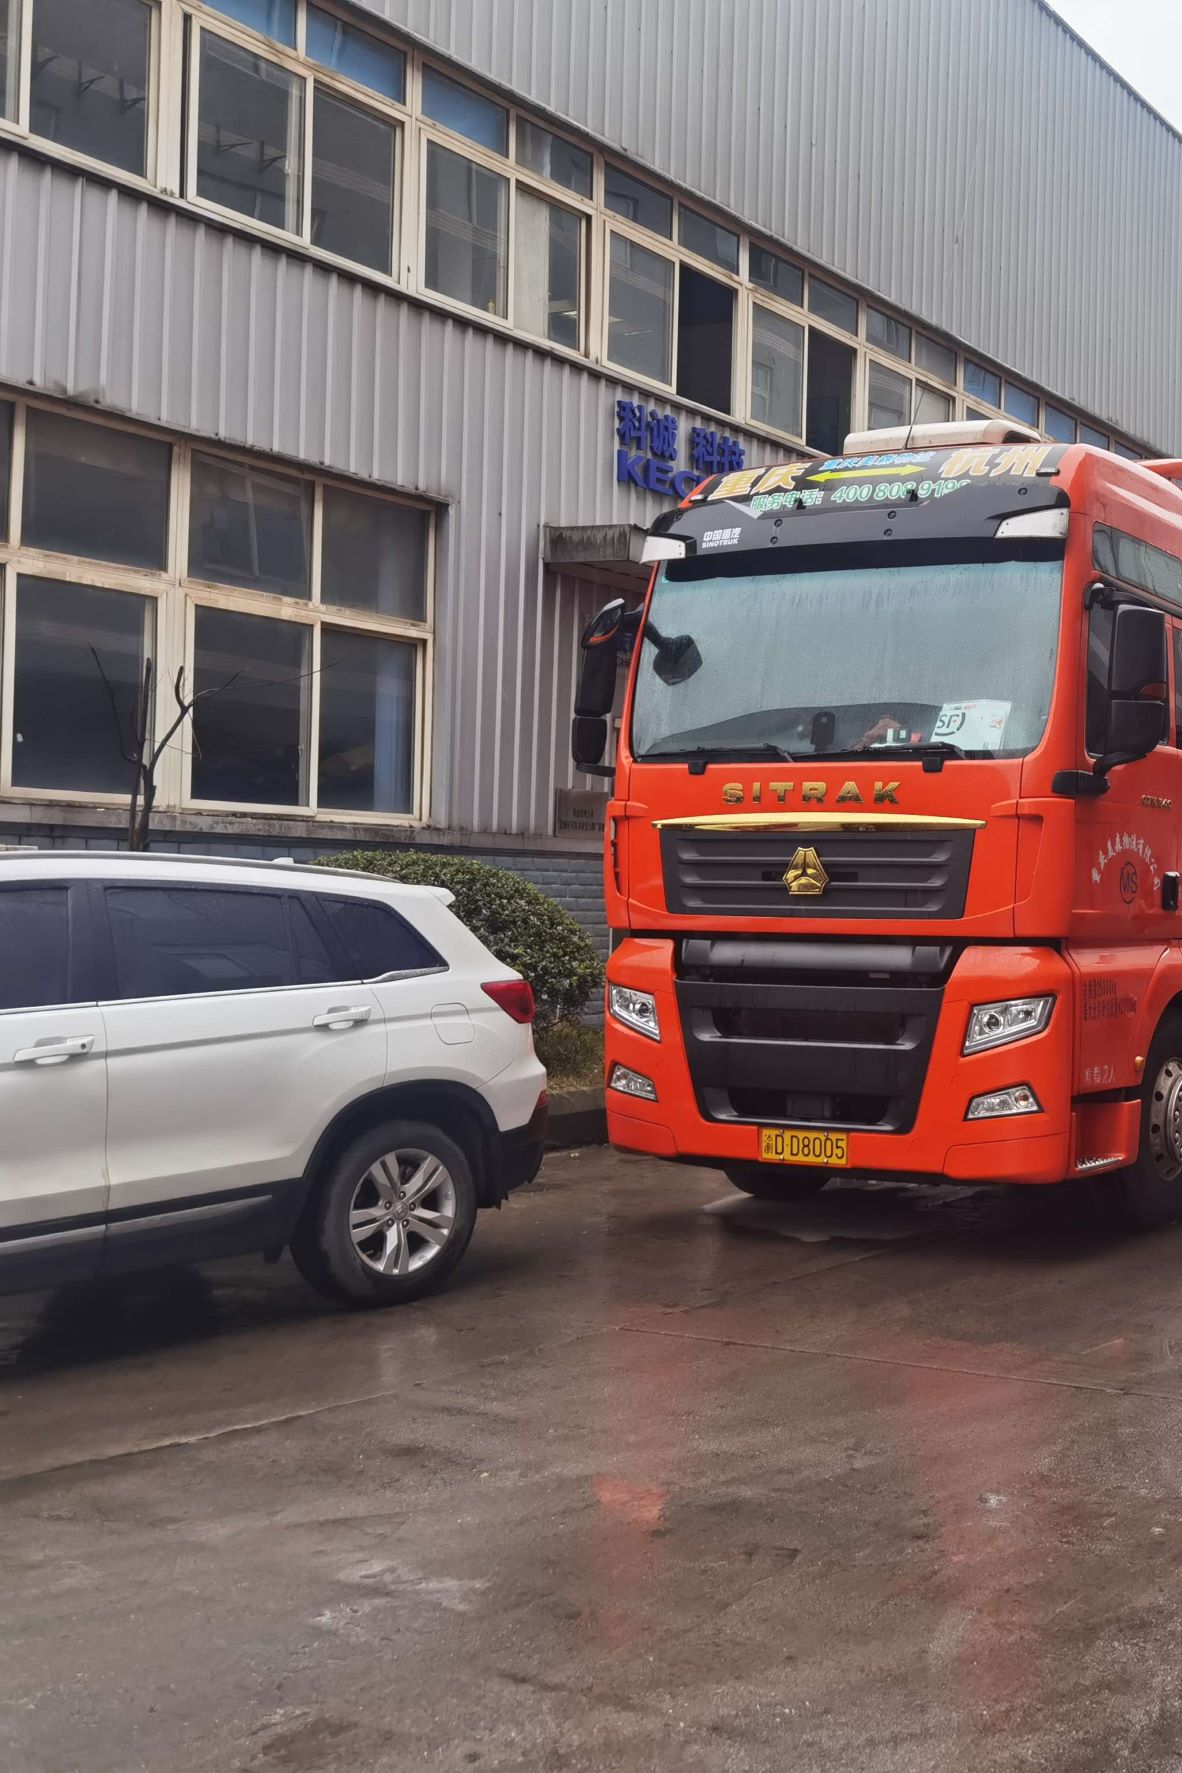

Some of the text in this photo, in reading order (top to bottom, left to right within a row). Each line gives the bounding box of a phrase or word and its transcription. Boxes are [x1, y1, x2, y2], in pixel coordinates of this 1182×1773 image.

[616, 400, 746, 474] 科诚 科技
[616, 449, 713, 500] KEC
[707, 446, 1052, 500] 重庆 杭州
[831, 484, 873, 503] 400
[873, 482, 916, 501] 808
[702, 538, 738, 548] SINOTRUK
[703, 527, 741, 541] 中国重汽
[722, 780, 901, 805] SITRAK
